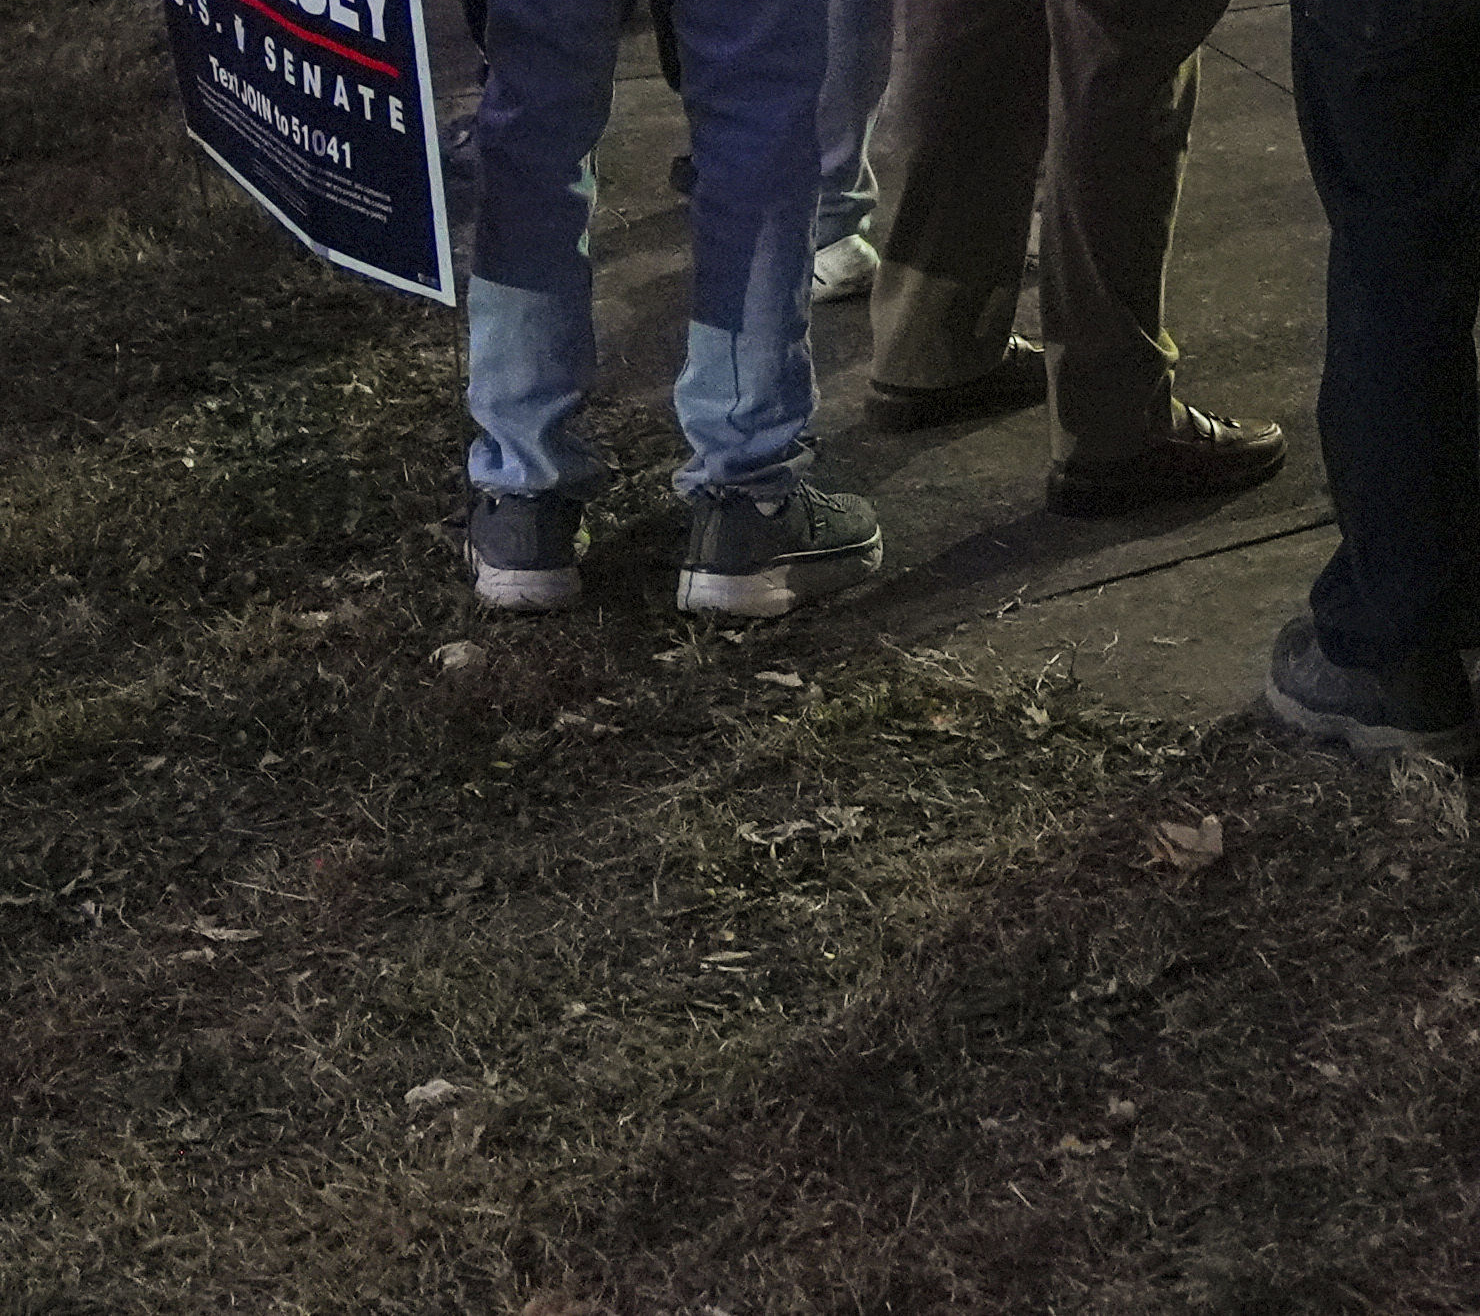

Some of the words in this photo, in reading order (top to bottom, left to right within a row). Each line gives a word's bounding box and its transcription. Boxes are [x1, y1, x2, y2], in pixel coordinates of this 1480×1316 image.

[208, 53, 241, 99] Text
[240, 80, 273, 125] JOIN
[273, 104, 290, 133] to
[290, 114, 352, 170] 51041
[263, 35, 407, 135] SENATE
